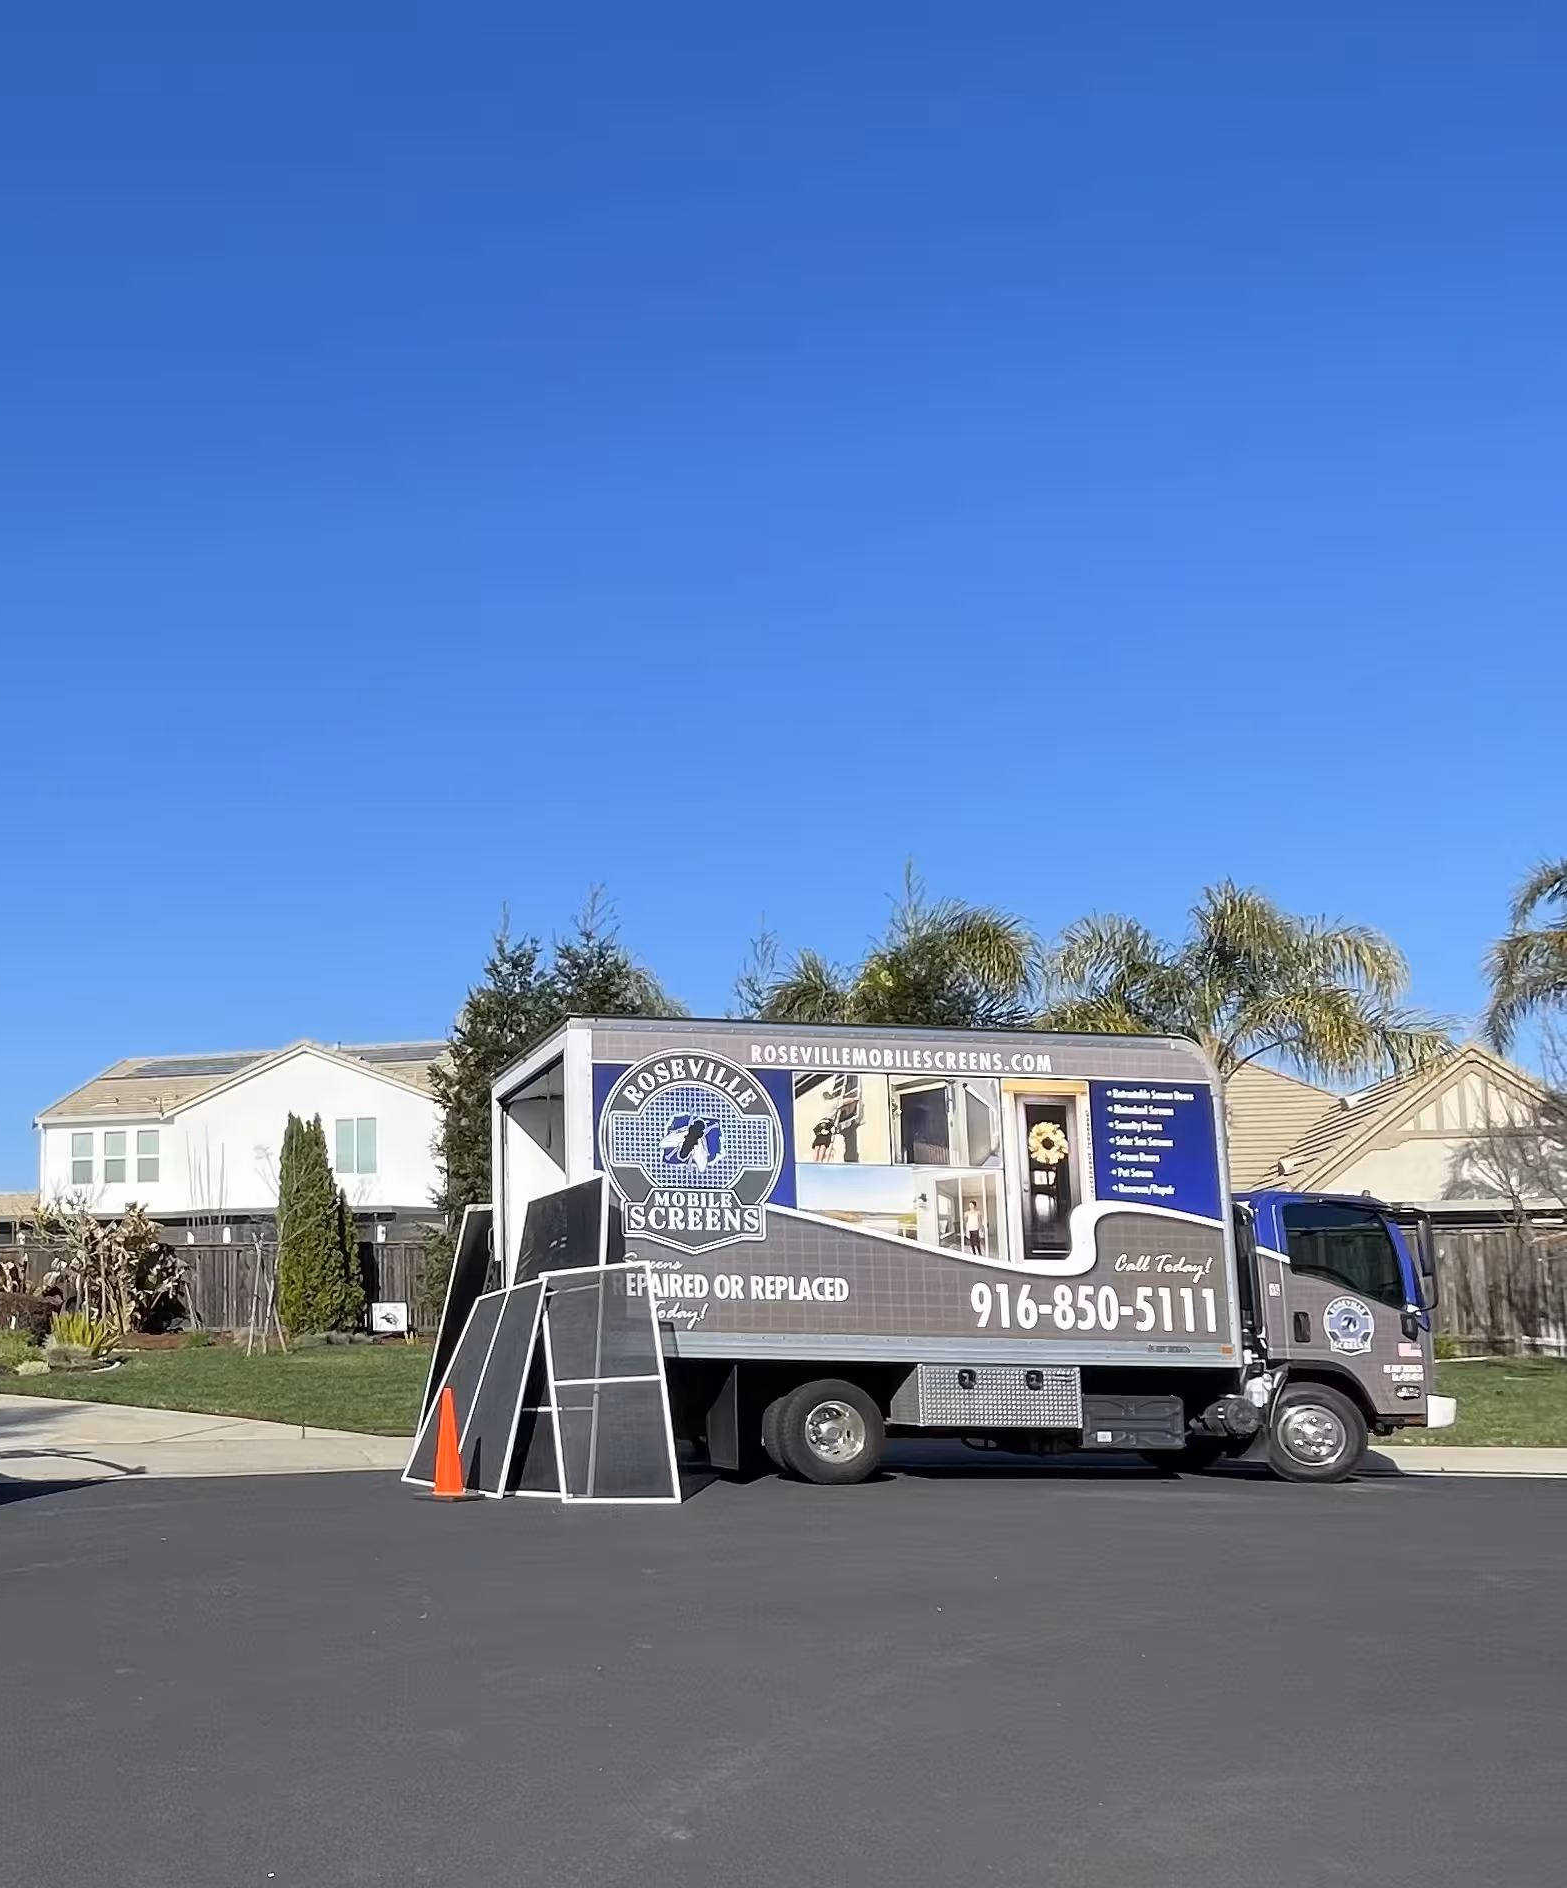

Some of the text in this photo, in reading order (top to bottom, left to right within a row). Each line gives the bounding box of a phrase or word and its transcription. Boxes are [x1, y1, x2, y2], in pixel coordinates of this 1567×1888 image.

[751, 1044, 1052, 1073] ROSEVILLEMOBILESCREENS.COM
[622, 1058, 758, 1109] ROSEVILLE
[654, 1191, 733, 1208] MOBILE
[630, 1206, 760, 1232] SCREENS
[1114, 1253, 1213, 1284] Call Today!
[714, 1274, 744, 1300] OR
[750, 1275, 850, 1302] REPLACED
[970, 1282, 1218, 1333] 916-850-5111
